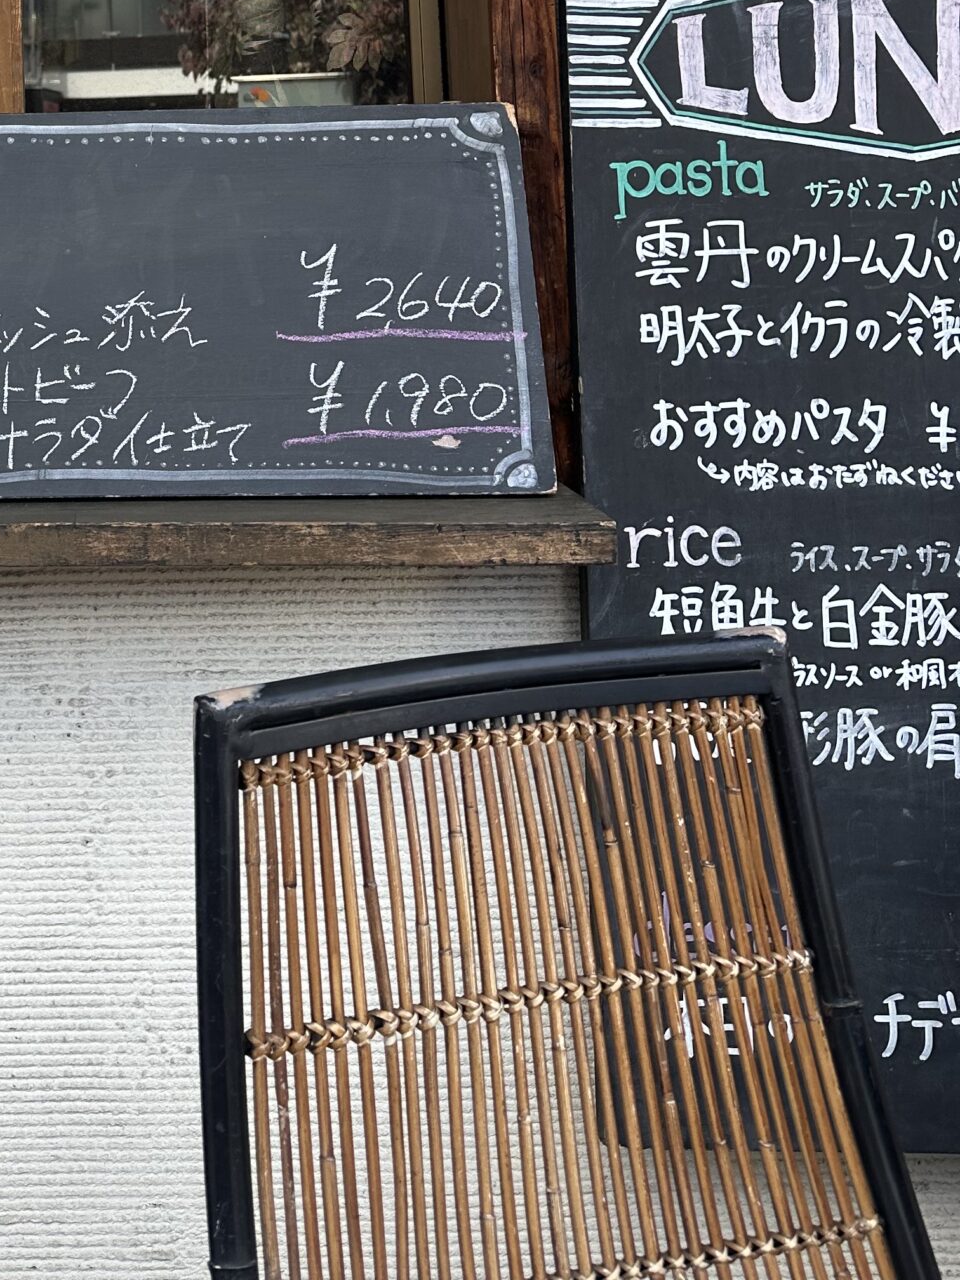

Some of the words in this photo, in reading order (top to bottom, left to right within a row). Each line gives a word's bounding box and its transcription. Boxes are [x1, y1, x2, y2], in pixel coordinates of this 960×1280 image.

[610, 140, 770, 220] pasta
[635, 218, 960, 288] 雲丹のクリームスパ
[639, 292, 960, 367] 明太子とイクラの冷製
[649, 397, 887, 454] おすすめパスタ
[623, 516, 742, 569] rice
[790, 541, 960, 577] ライス、スープ、サラ
[791, 656, 863, 690] ラスソース
